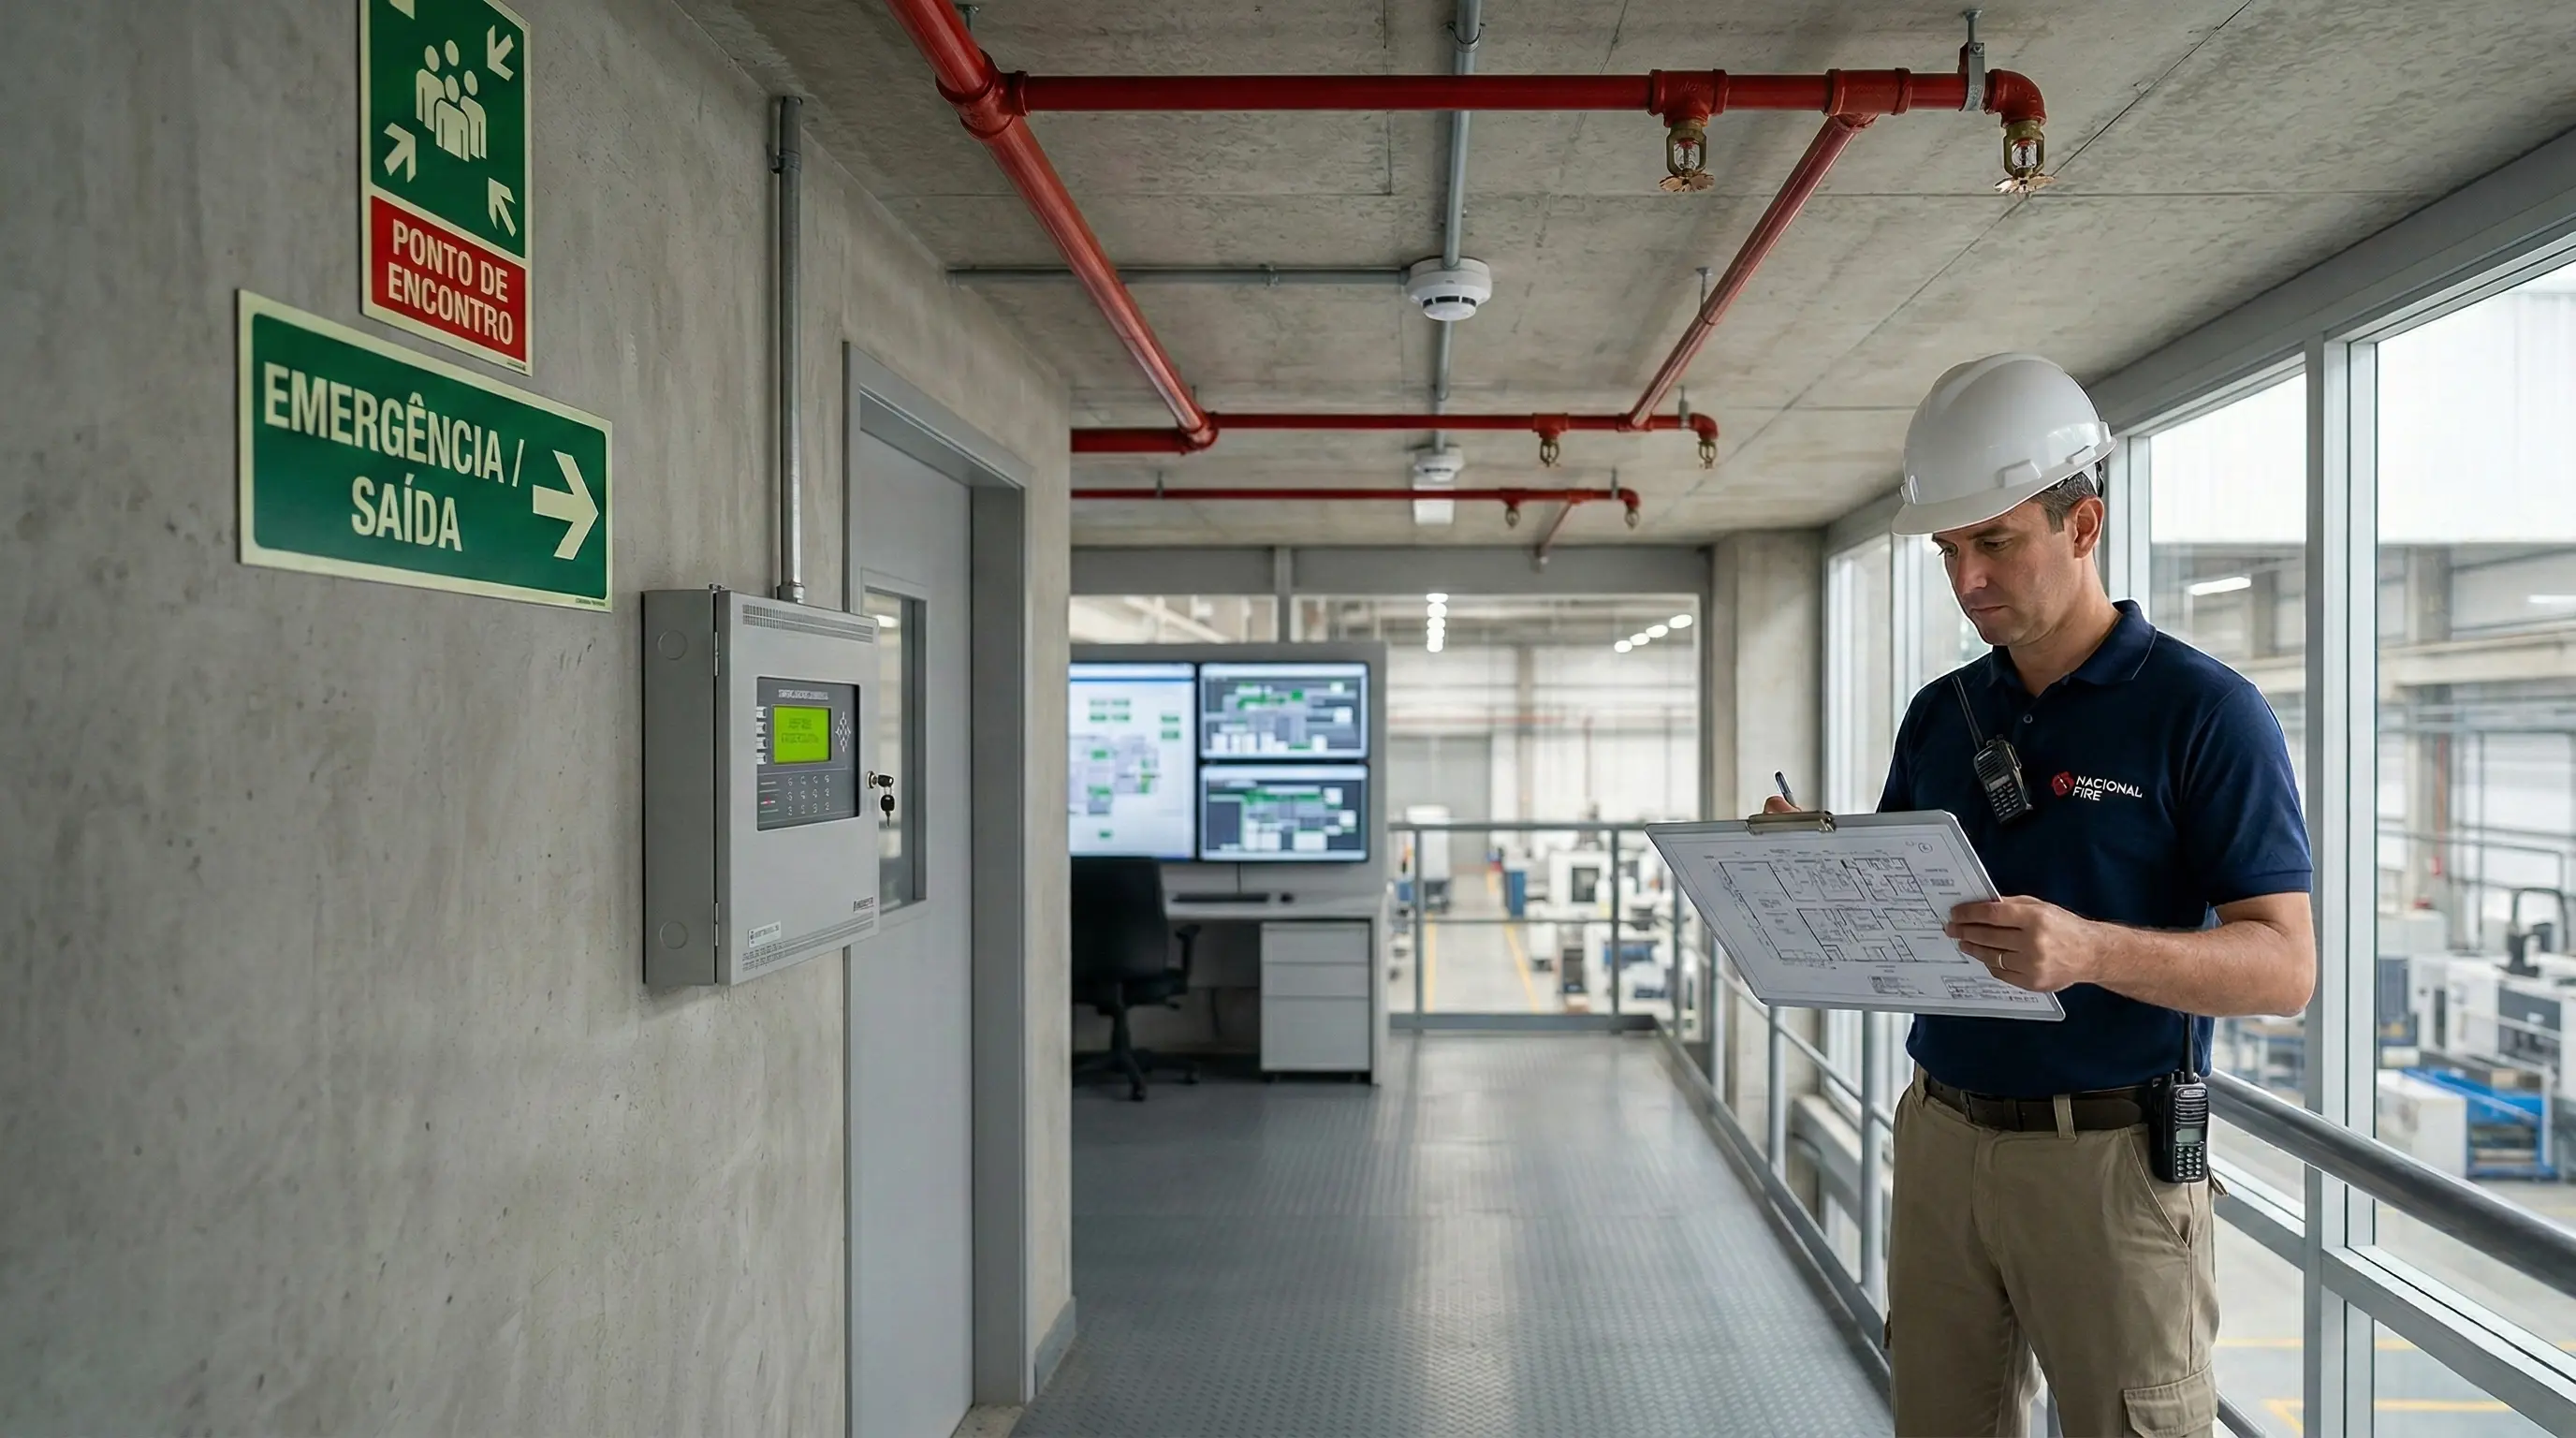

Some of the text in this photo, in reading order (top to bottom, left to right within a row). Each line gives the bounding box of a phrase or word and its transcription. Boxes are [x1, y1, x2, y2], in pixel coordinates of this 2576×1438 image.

[393, 218, 509, 303] PONTO DE
[388, 264, 514, 345] ENCONTRO
[264, 360, 525, 488] EMERGÊNCIA /
[351, 473, 463, 552] SAÍDA
[2072, 786, 2102, 800] FIRE
[2076, 776, 2143, 798] NACIONAL
